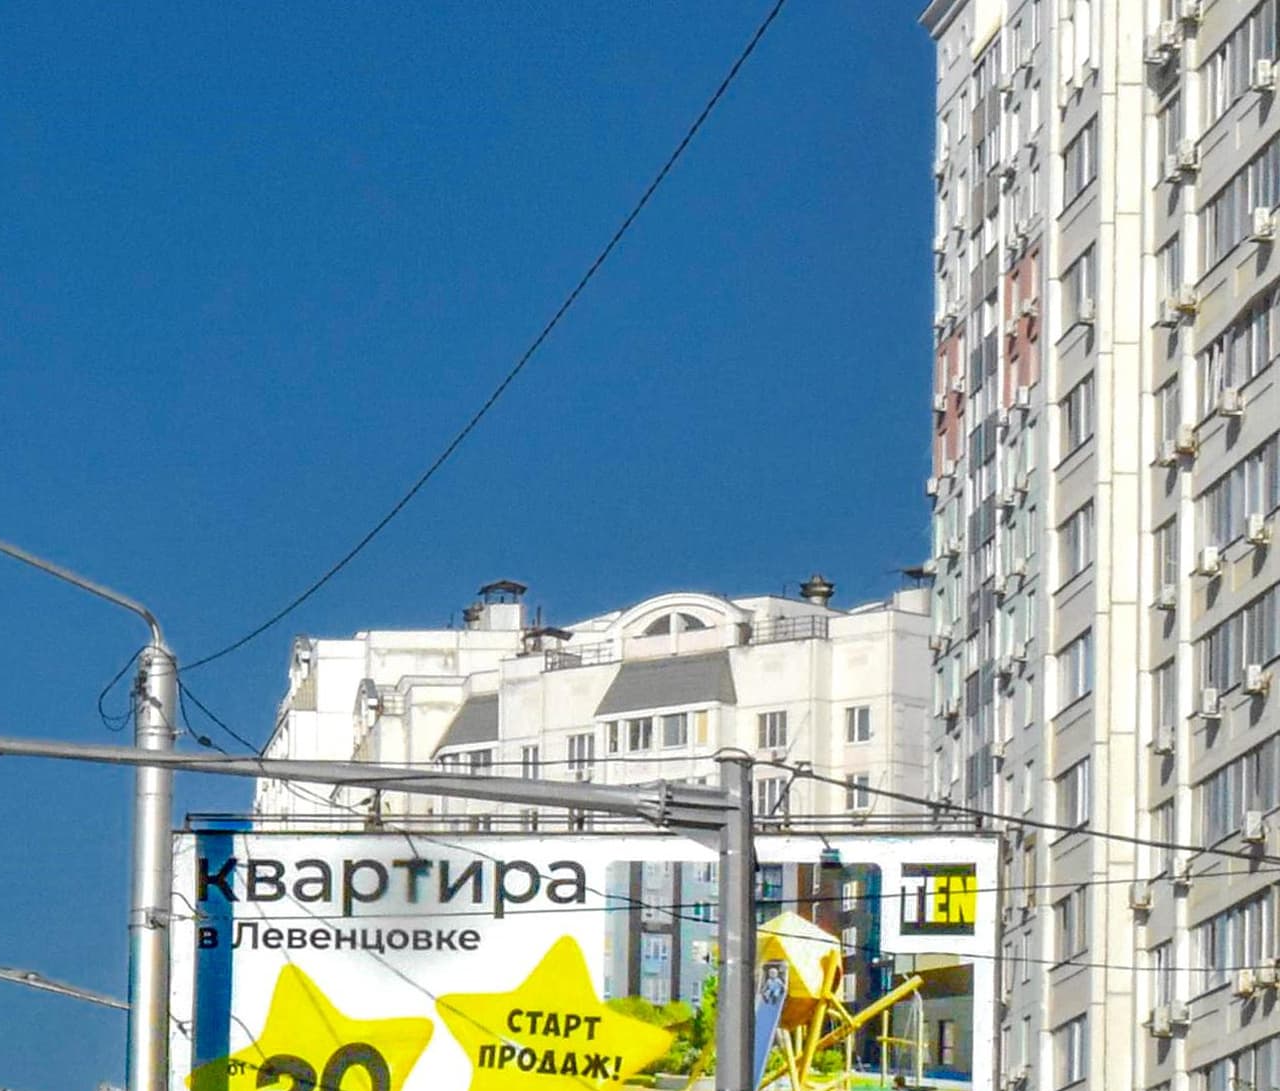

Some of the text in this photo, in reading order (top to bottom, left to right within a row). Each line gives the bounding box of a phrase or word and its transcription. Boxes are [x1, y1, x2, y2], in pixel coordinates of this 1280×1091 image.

[198, 857, 587, 919] квартира
[900, 875, 977, 924] TEN
[198, 922, 482, 953] в Левенцовке
[507, 1008, 602, 1040] СТАРТ
[478, 1044, 623, 1081] ПРОДАЖ!
